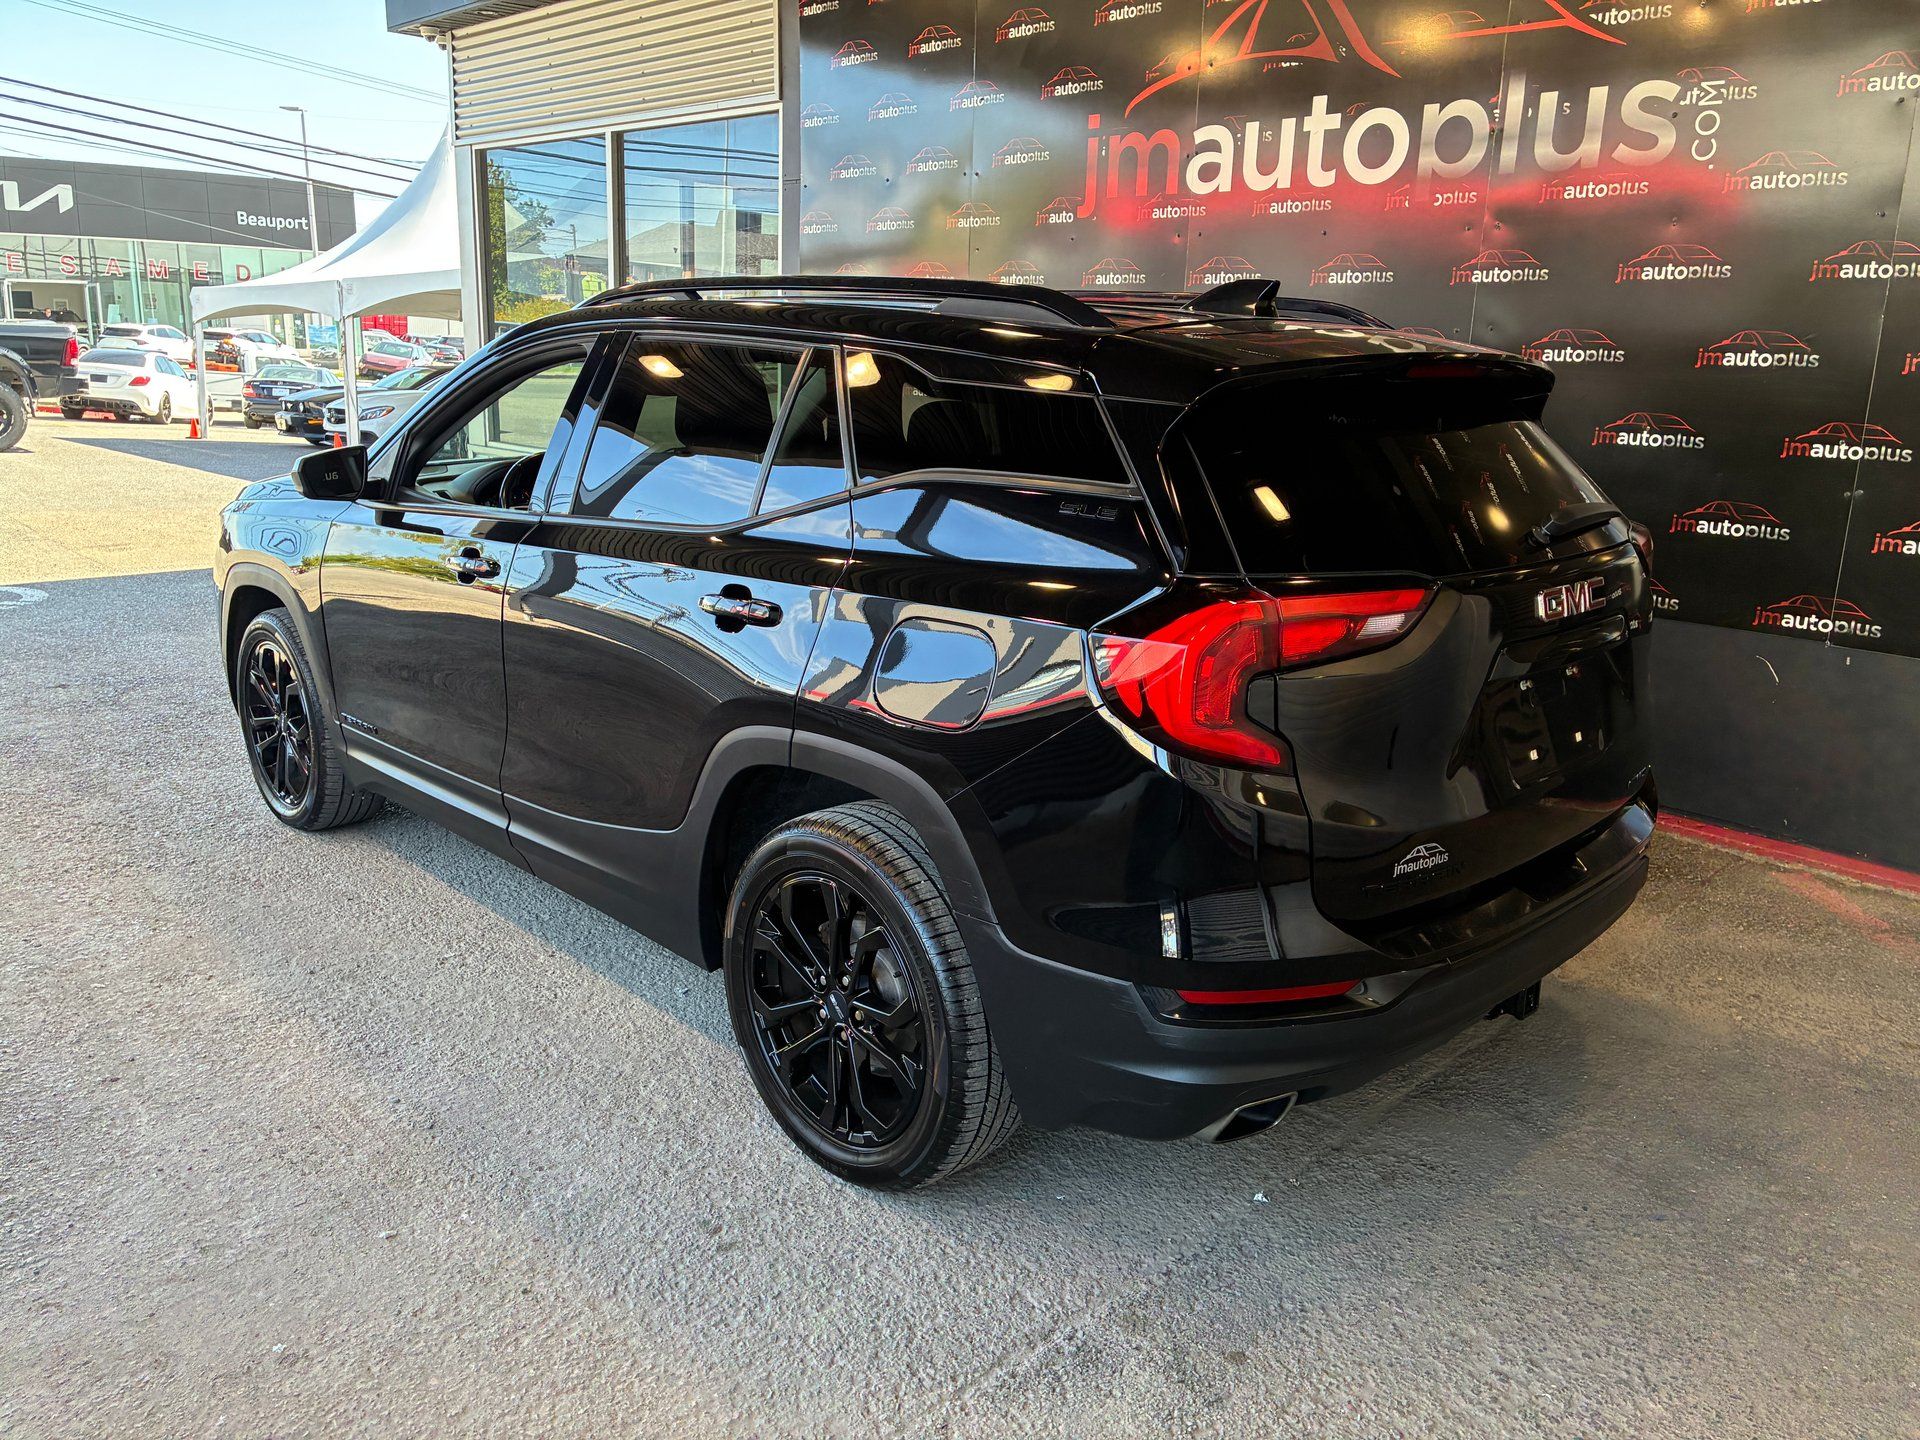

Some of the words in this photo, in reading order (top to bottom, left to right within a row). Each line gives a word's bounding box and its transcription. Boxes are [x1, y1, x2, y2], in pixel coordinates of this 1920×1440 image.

[800, 0, 839, 16] autoplus
[1094, 1, 1162, 26] jmautoplus
[1589, 4, 1673, 26] utoplus
[995, 19, 1056, 43] jmautoplus
[908, 36, 962, 58] jmautoplus
[830, 51, 878, 70] jmautoplus
[1041, 78, 1104, 100] jmautoplus
[1836, 72, 1920, 98] jmauto
[949, 92, 1005, 112] jmautoplus
[800, 114, 840, 128] autoplus
[868, 104, 918, 122] jmautoplus
[1077, 69, 1682, 219] jmautoplus
[905, 158, 959, 176] jmautoplus
[991, 149, 1050, 168] jmautoplus
[830, 166, 877, 182] jmautoplus
[1721, 169, 1848, 193] jmautoplus
[1539, 179, 1649, 203] jmautoplus
[1252, 196, 1332, 217] jmautoplus
[236, 211, 309, 231] Beauport
[800, 223, 838, 234] autoplus
[866, 219, 915, 234] jmautoplus
[946, 215, 1001, 231] jmautoplus
[60, 255, 286, 282] SAMED
[1310, 268, 1394, 286] jmautoplus
[1450, 267, 1550, 286] jmautoplus
[1615, 263, 1732, 284] jmautoplus
[1809, 260, 1920, 282] jmautopl
[1082, 272, 1146, 287] jmautoplus
[1695, 348, 1820, 368] jmautoplus
[1592, 426, 1705, 449] jmautoplus
[1780, 438, 1913, 463] jmautoplus
[1670, 514, 1791, 541] jmautoplus
[1535, 577, 1607, 623] GMC
[1753, 606, 1882, 638] jmautoplus
[1393, 853, 1449, 878] jmautoplus
